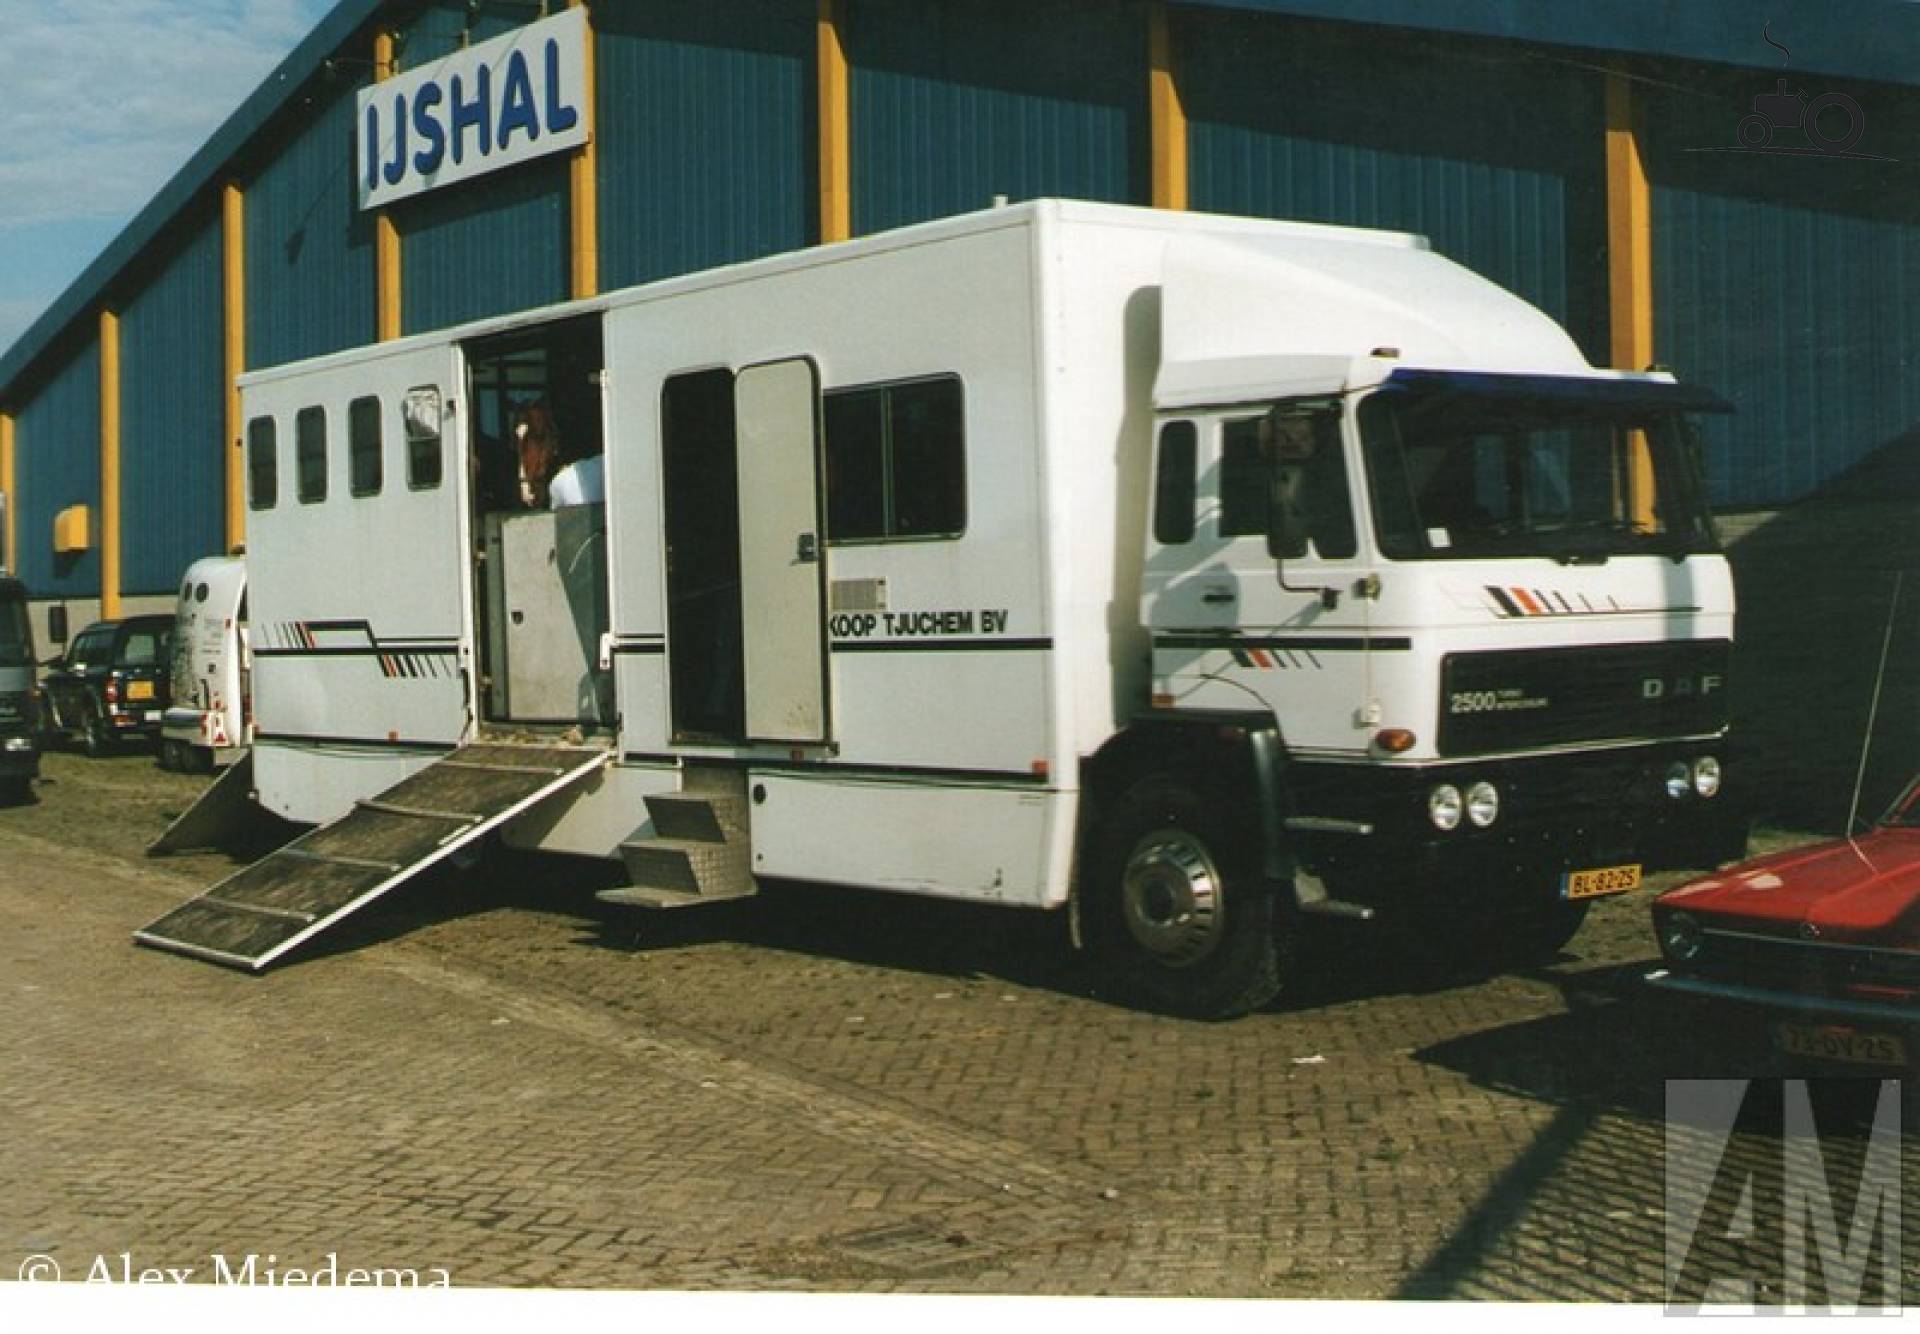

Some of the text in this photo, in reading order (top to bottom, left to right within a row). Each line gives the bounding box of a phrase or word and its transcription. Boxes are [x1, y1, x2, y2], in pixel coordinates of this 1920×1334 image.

[367, 37, 578, 191] IJSHAL
[883, 611, 973, 636] TJUCHEM
[981, 609, 1009, 634] BV
[1643, 676, 1722, 698] DAF
[1451, 690, 1496, 714] 2500
